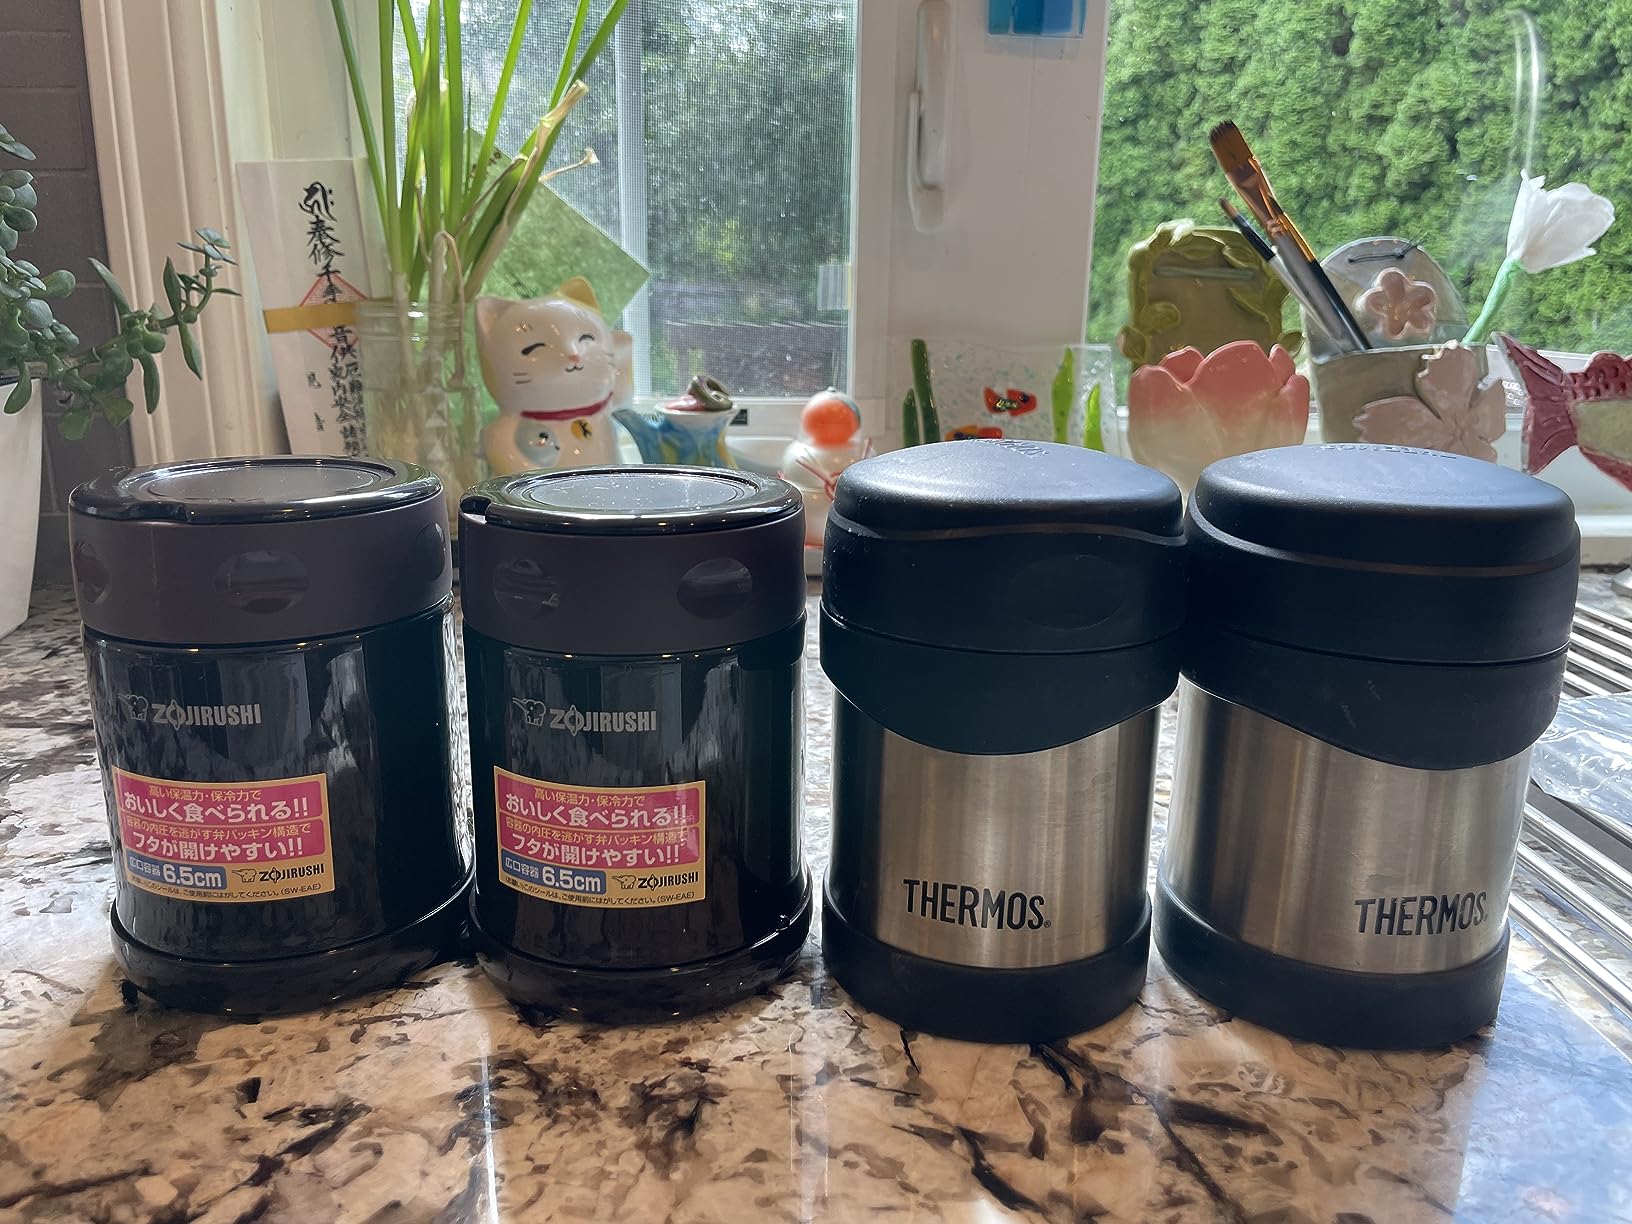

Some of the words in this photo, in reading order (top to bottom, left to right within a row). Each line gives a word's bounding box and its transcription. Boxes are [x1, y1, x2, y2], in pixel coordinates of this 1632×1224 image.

[151, 700, 262, 730] ZOJIRUSHI
[549, 704, 657, 736] ZOJIRUSHI
[163, 863, 222, 888] 6.5cm
[259, 863, 325, 884] ZOJIRUSHI
[542, 866, 601, 892] 6.5cm
[637, 871, 699, 891] ZOJIRUSHI
